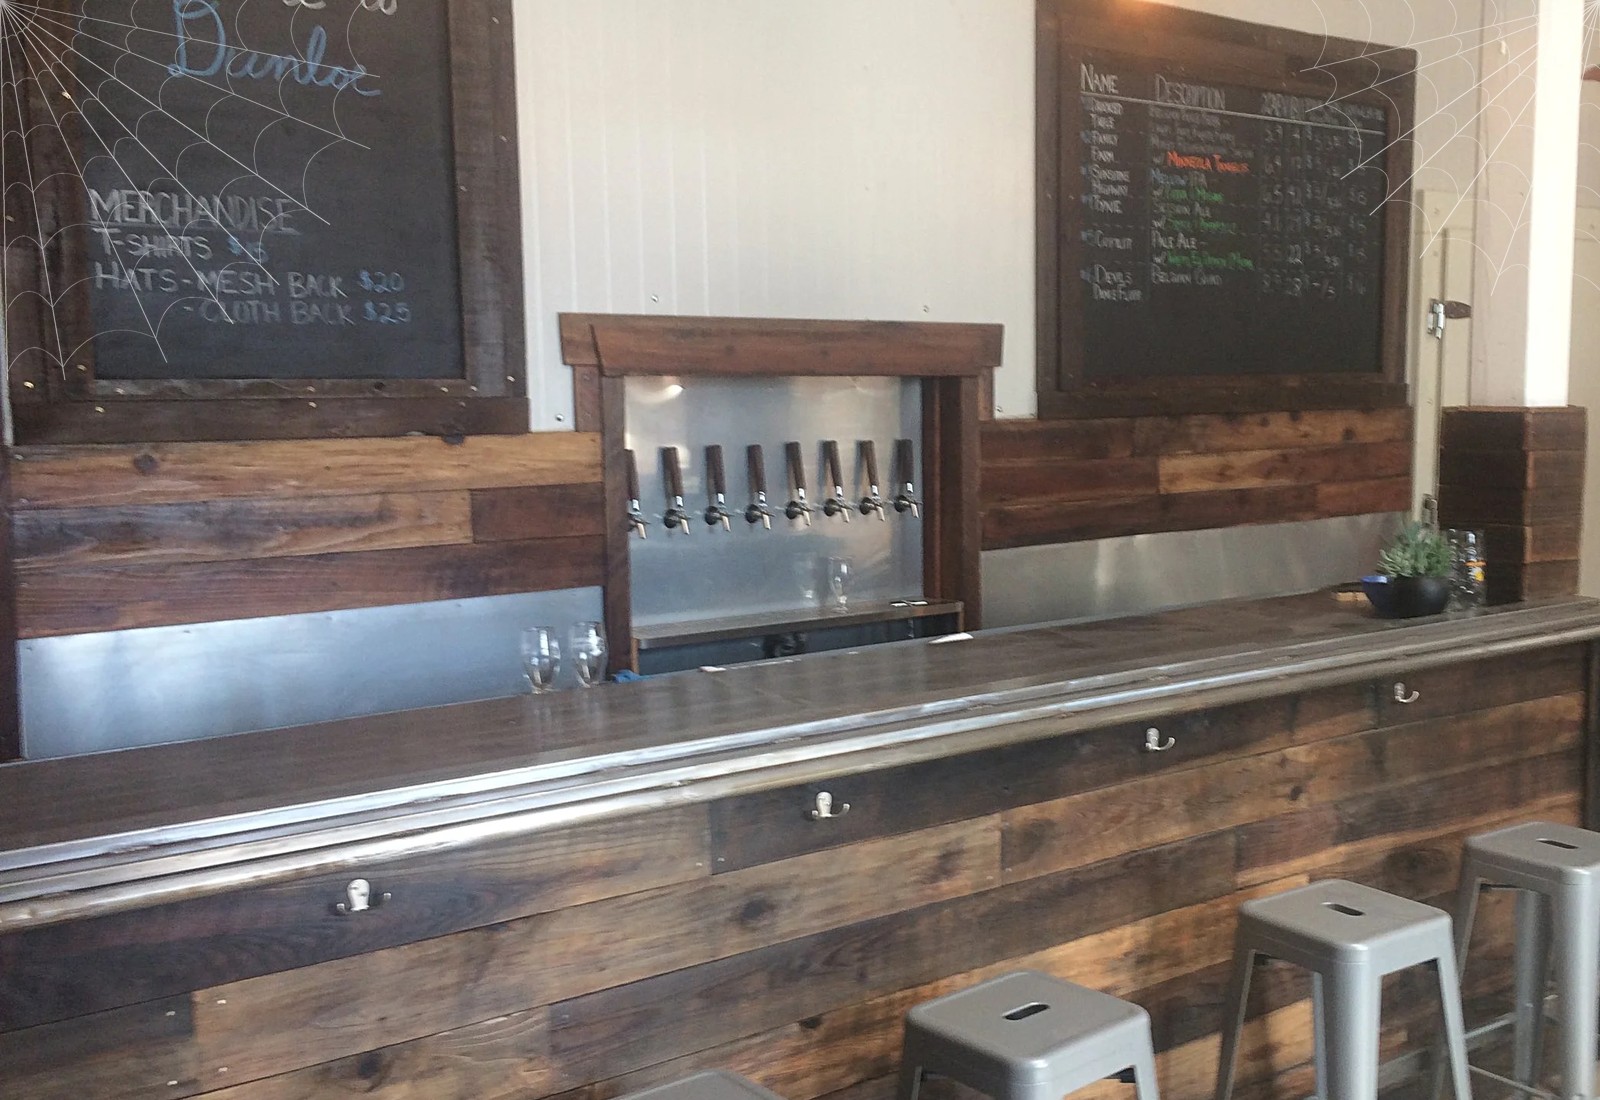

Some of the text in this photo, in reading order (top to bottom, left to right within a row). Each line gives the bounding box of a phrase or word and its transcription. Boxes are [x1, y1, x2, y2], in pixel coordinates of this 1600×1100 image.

[88, 188, 299, 235] MERCHANDISE
[92, 228, 213, 260] T-SHIRTS
[287, 271, 348, 299] BACK
[357, 269, 405, 294] $20
[290, 300, 357, 326] BACK
[362, 299, 412, 325] $25
